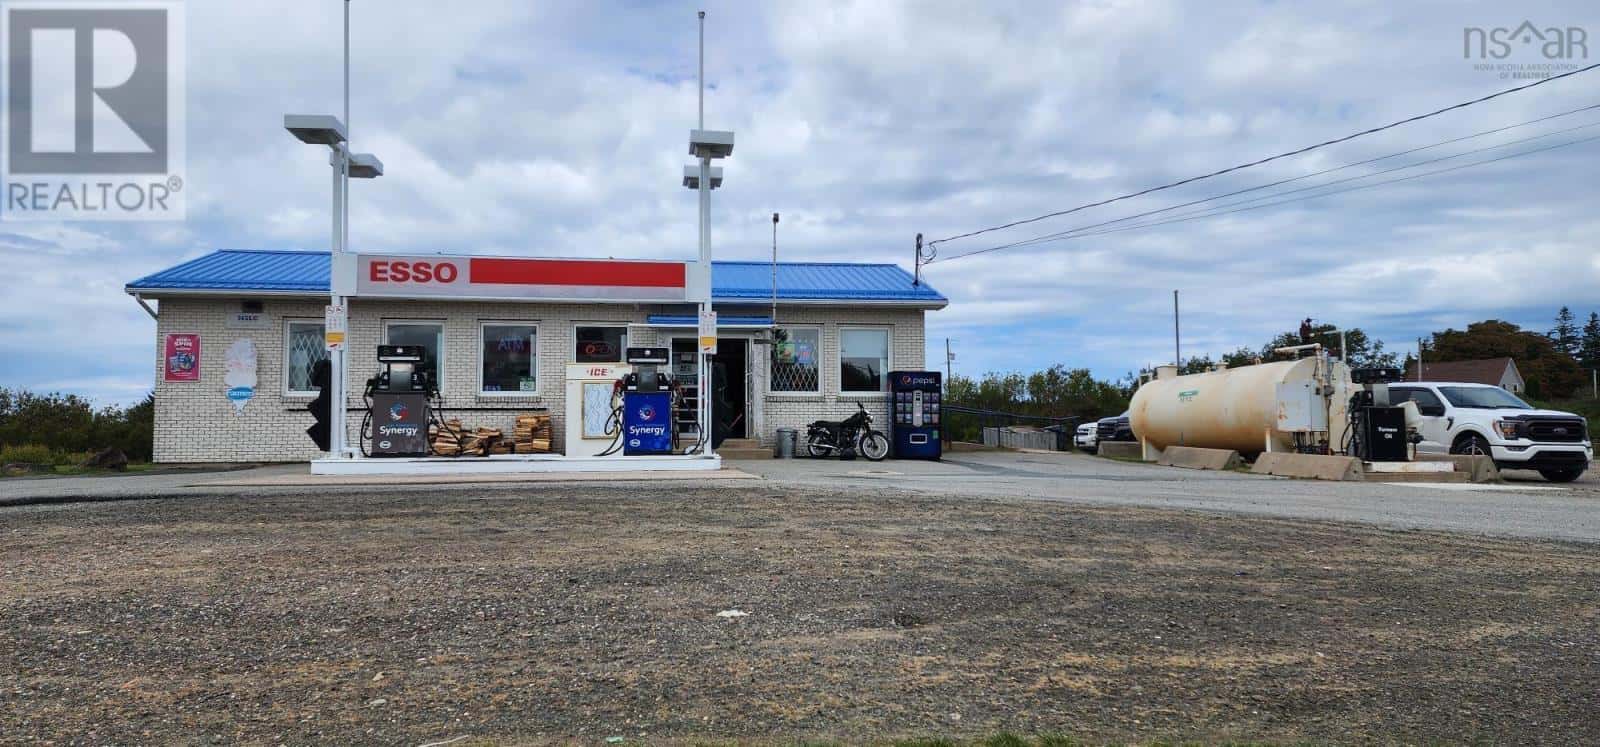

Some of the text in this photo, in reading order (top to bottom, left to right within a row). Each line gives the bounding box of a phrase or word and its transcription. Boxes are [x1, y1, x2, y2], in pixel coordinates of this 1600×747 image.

[369, 260, 458, 284] ESSO
[585, 343, 616, 354] OPEN
[590, 368, 609, 377] ICE
[912, 375, 936, 386] pepsi
[379, 425, 418, 437] Synergy
[629, 424, 665, 436] Synergy
